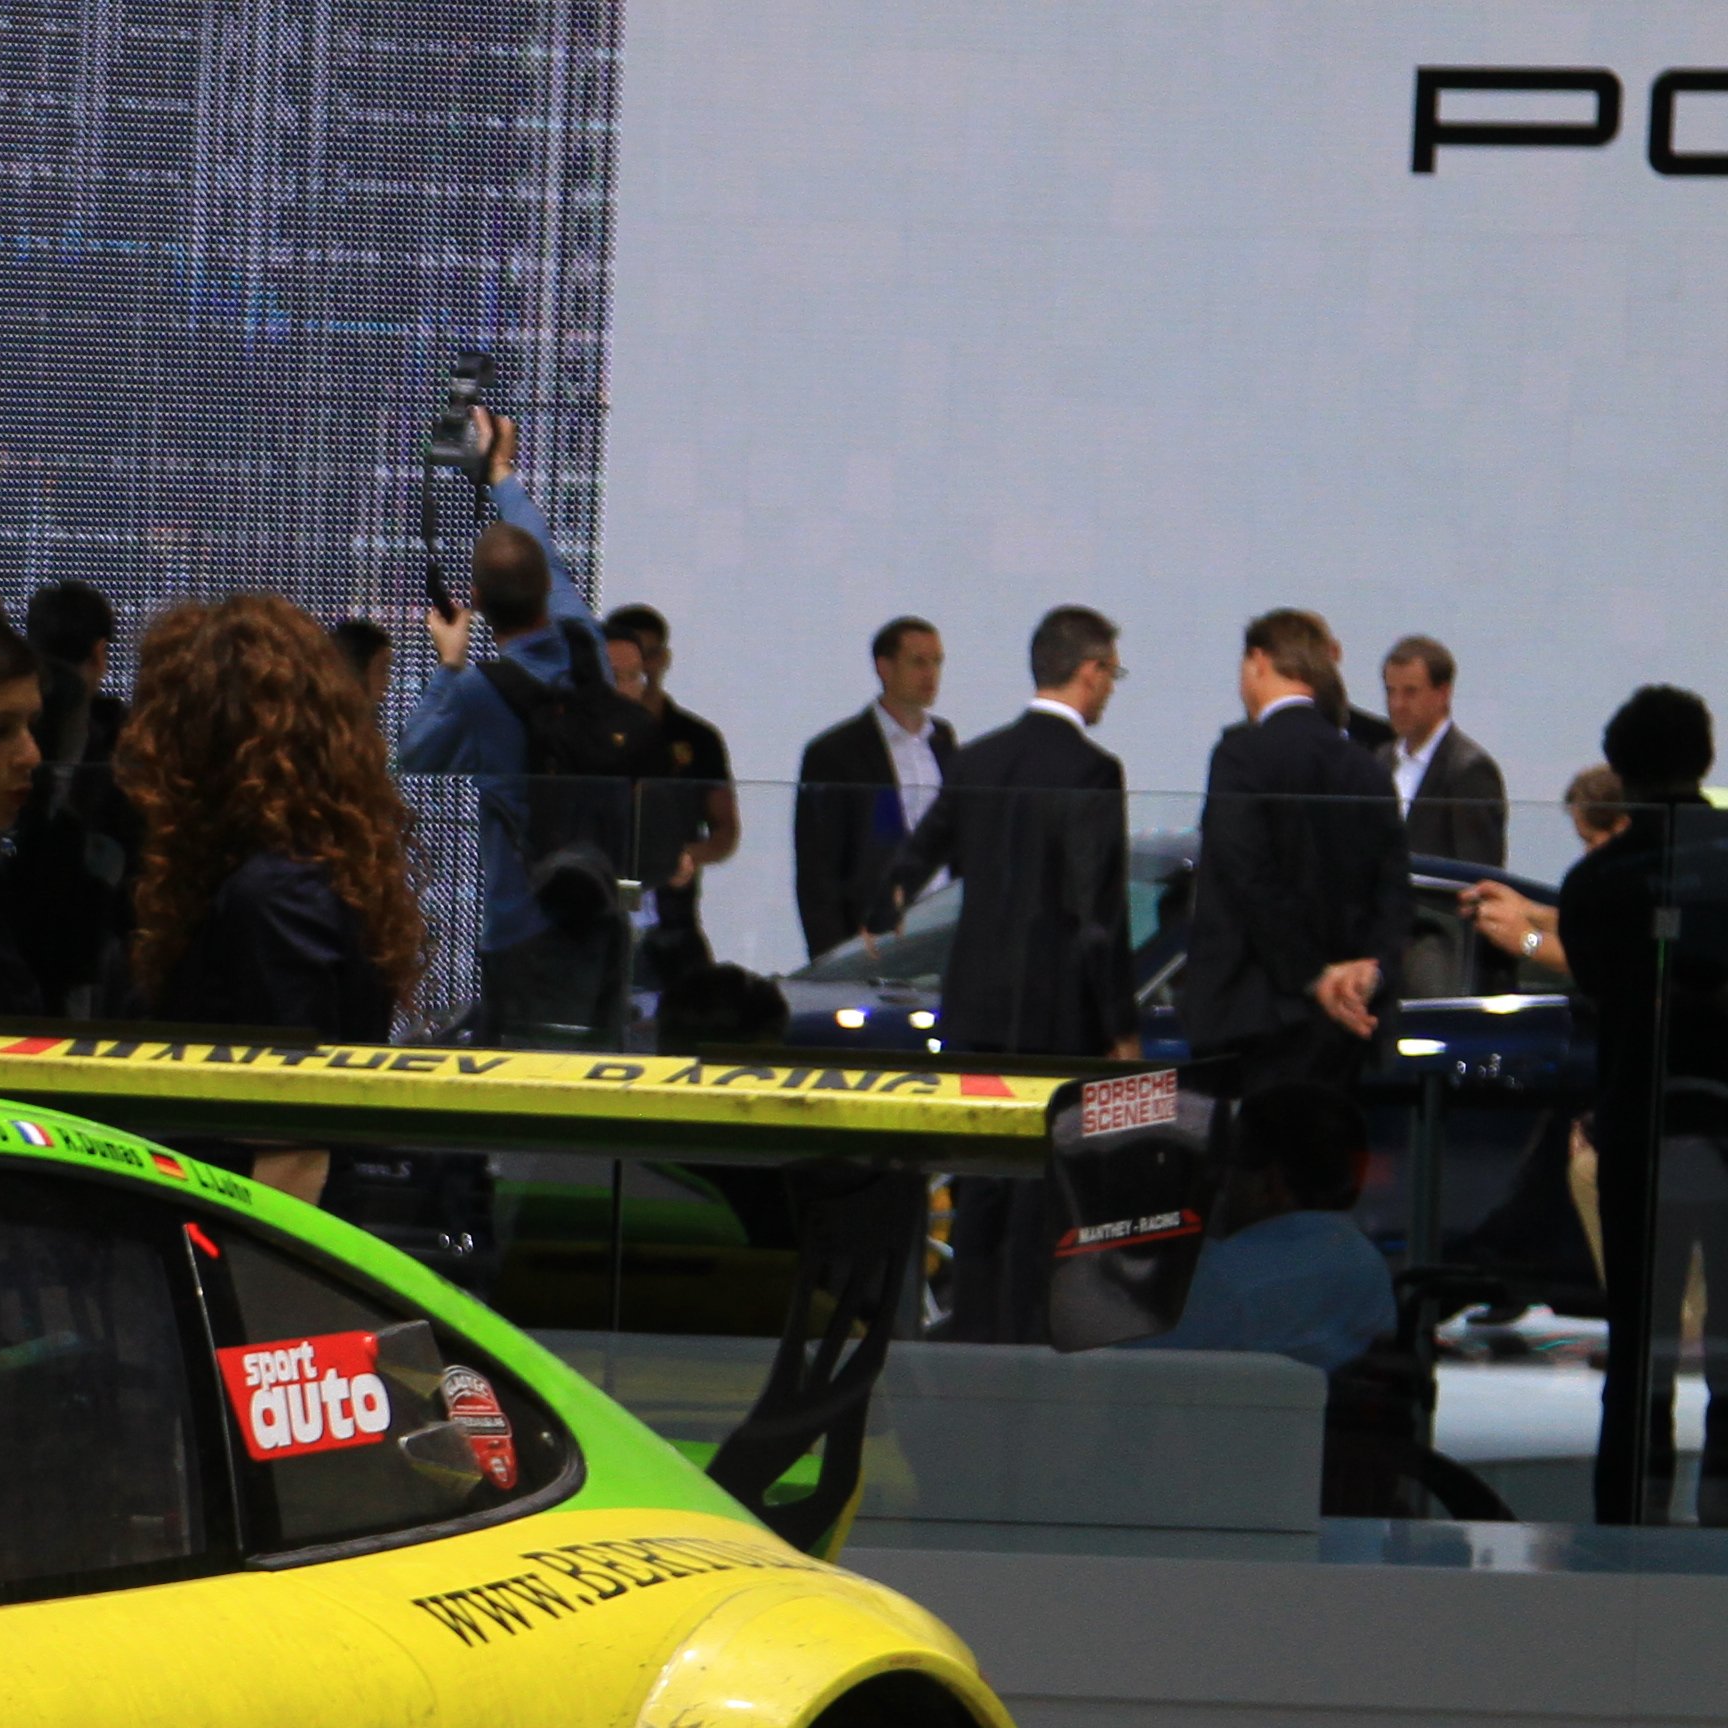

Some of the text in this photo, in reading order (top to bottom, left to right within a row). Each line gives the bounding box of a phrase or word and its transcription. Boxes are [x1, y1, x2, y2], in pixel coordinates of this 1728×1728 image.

[1082, 1071, 1177, 1109] PORSCHE
[1082, 1100, 1151, 1134] SCENE
[243, 1341, 318, 1388] sport
[249, 1371, 392, 1451] auto
